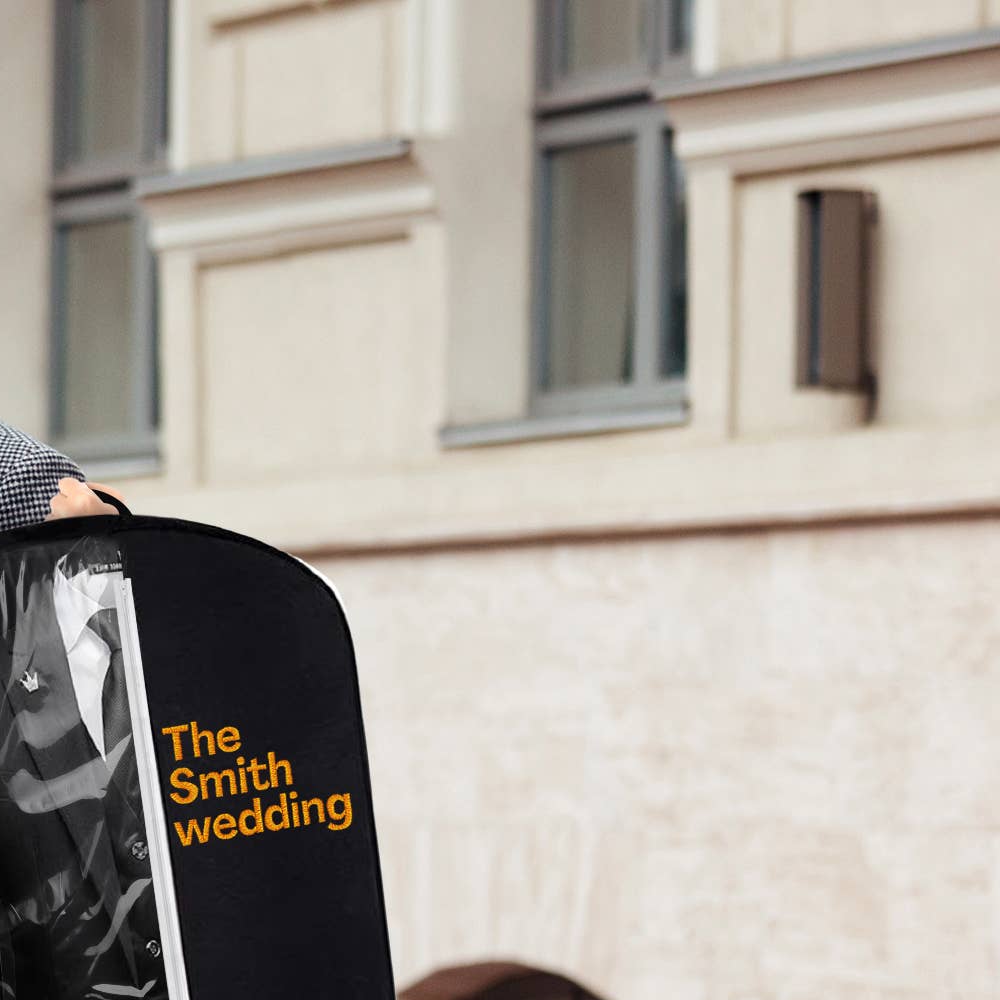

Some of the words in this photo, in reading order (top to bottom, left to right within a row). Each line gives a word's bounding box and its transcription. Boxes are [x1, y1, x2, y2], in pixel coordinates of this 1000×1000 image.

[161, 720, 242, 761] The
[169, 751, 294, 805] Smith
[173, 791, 353, 847] wedding
